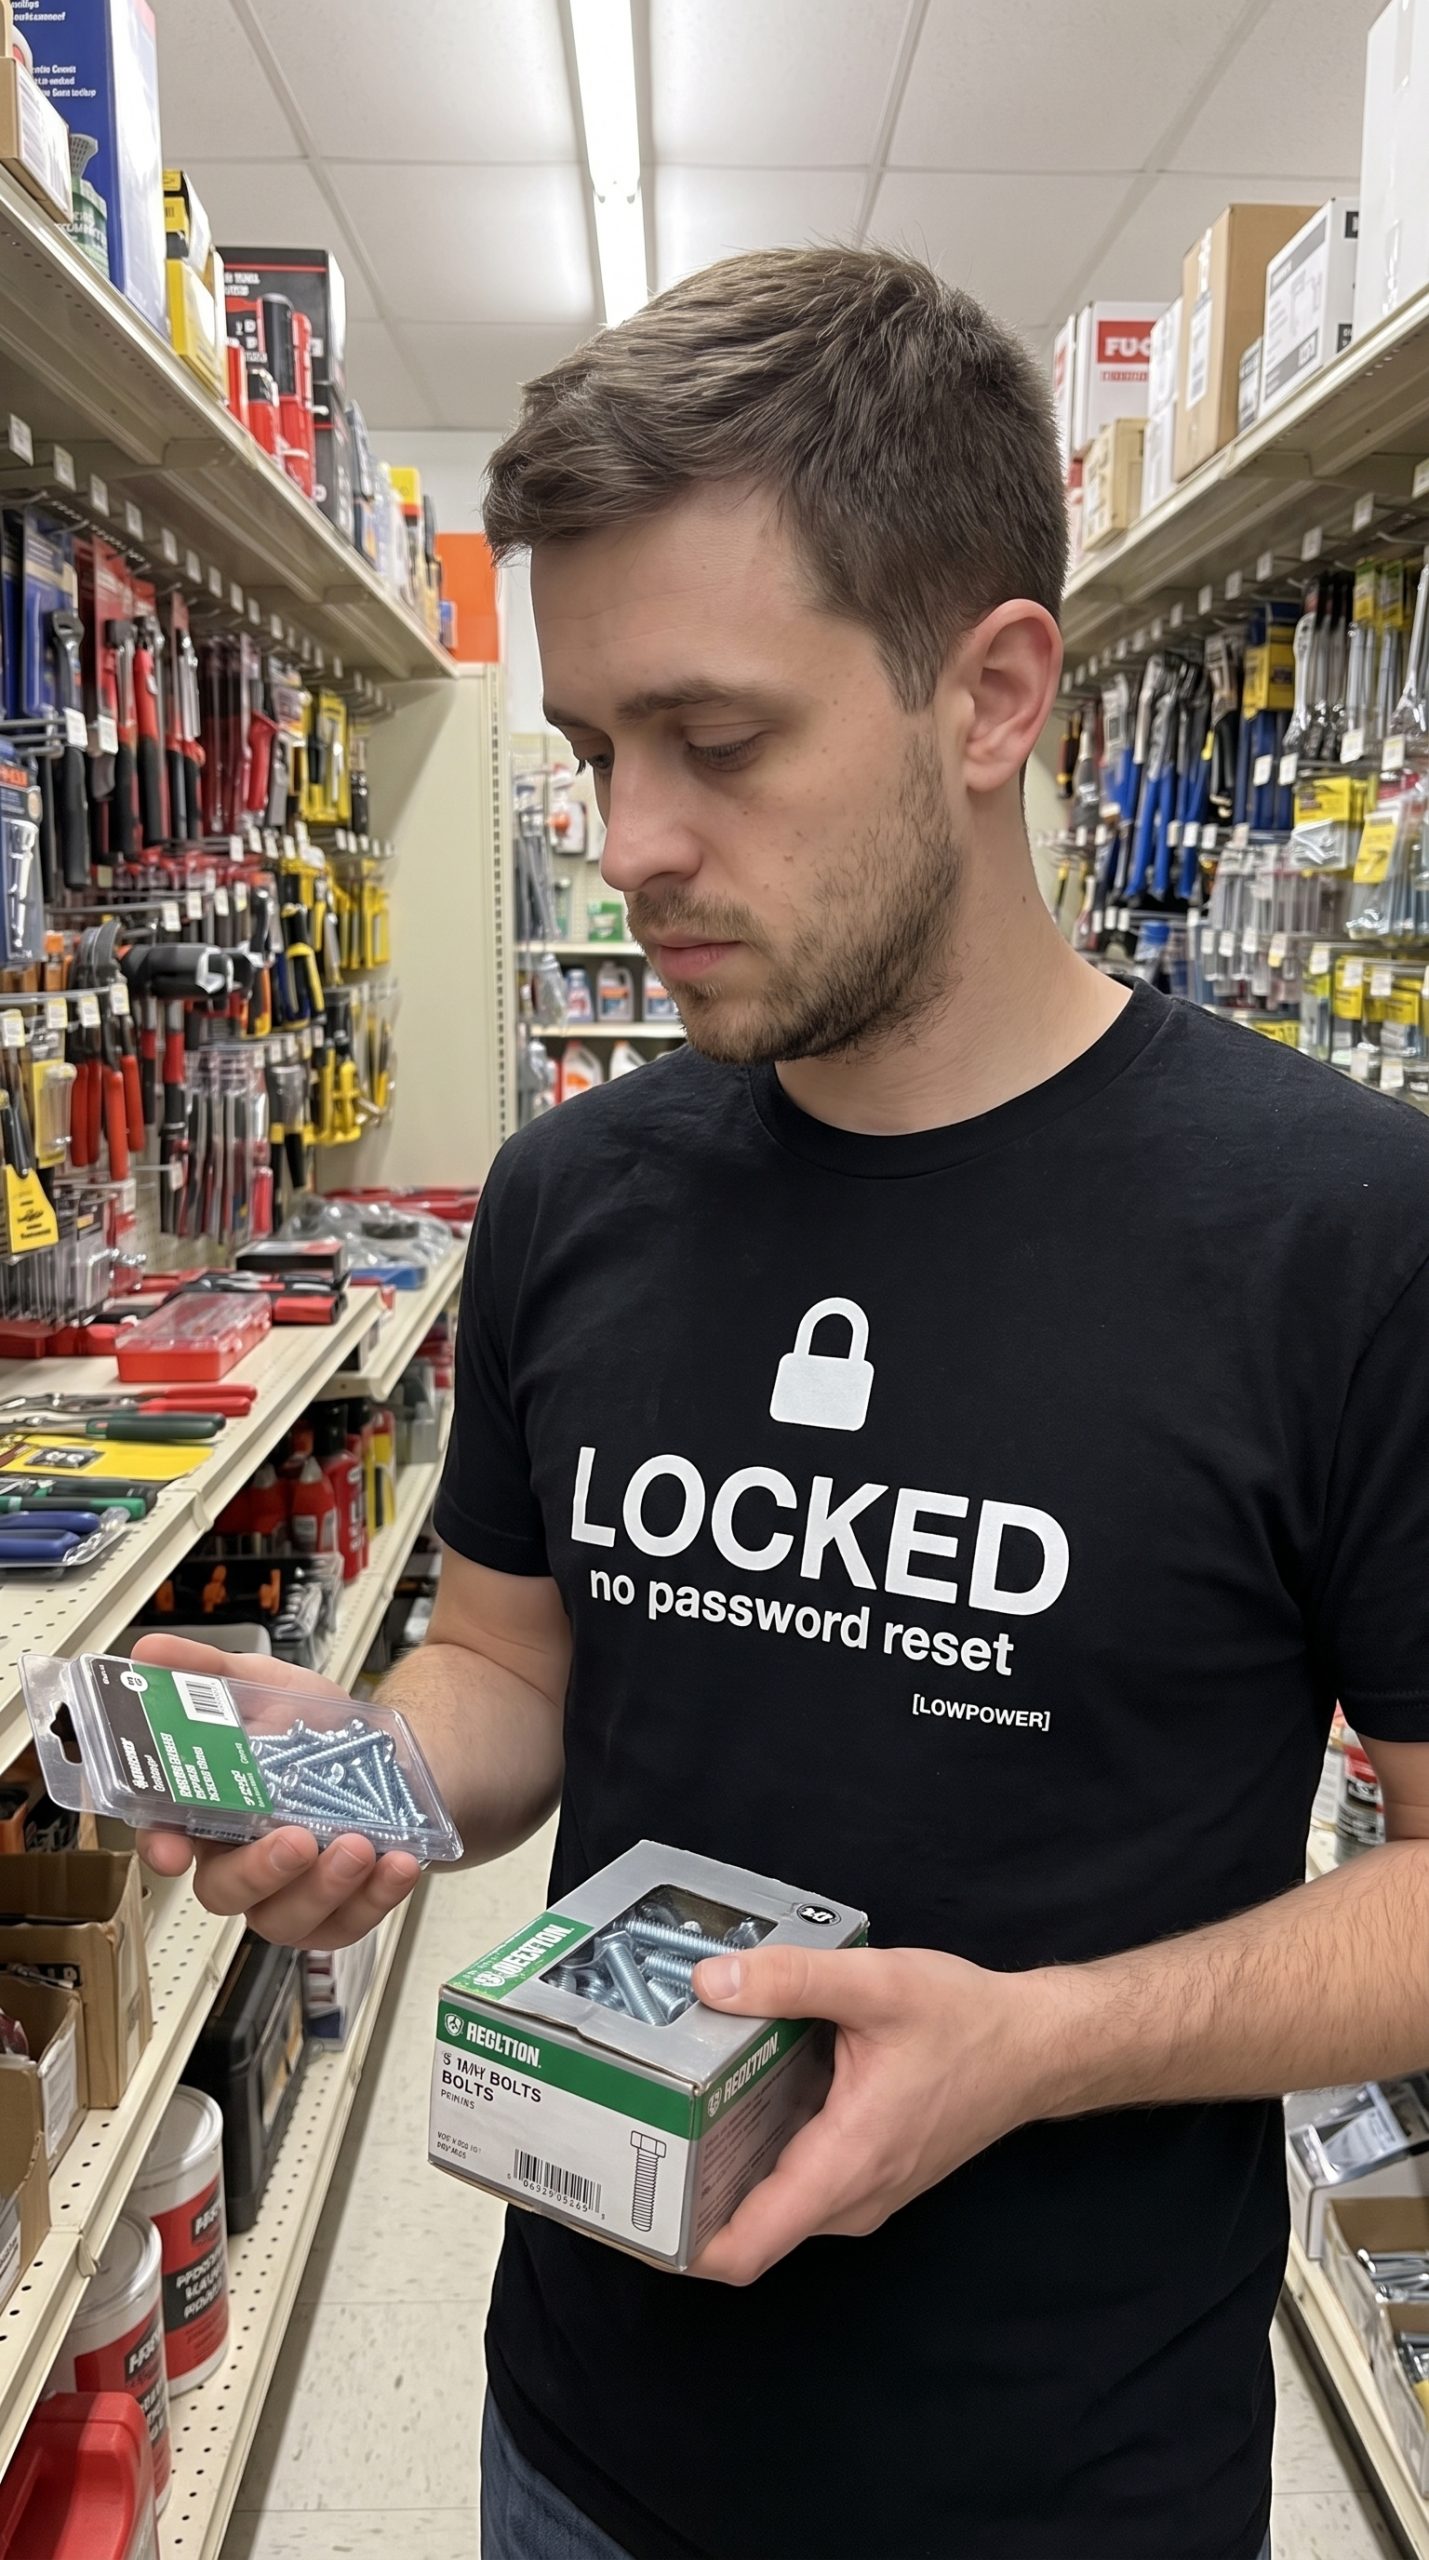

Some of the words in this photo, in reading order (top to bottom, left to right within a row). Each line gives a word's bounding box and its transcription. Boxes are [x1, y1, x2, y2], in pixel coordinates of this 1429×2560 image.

[571, 1447, 1069, 1615] LOCKED
[590, 1569, 635, 1604] no
[649, 1581, 870, 1650] password
[884, 1623, 1015, 1676] reset
[912, 1693, 1051, 1731] [LOWPOWER]
[442, 2069, 494, 2101] BOLTS
[489, 2071, 542, 2102] BOLTS
